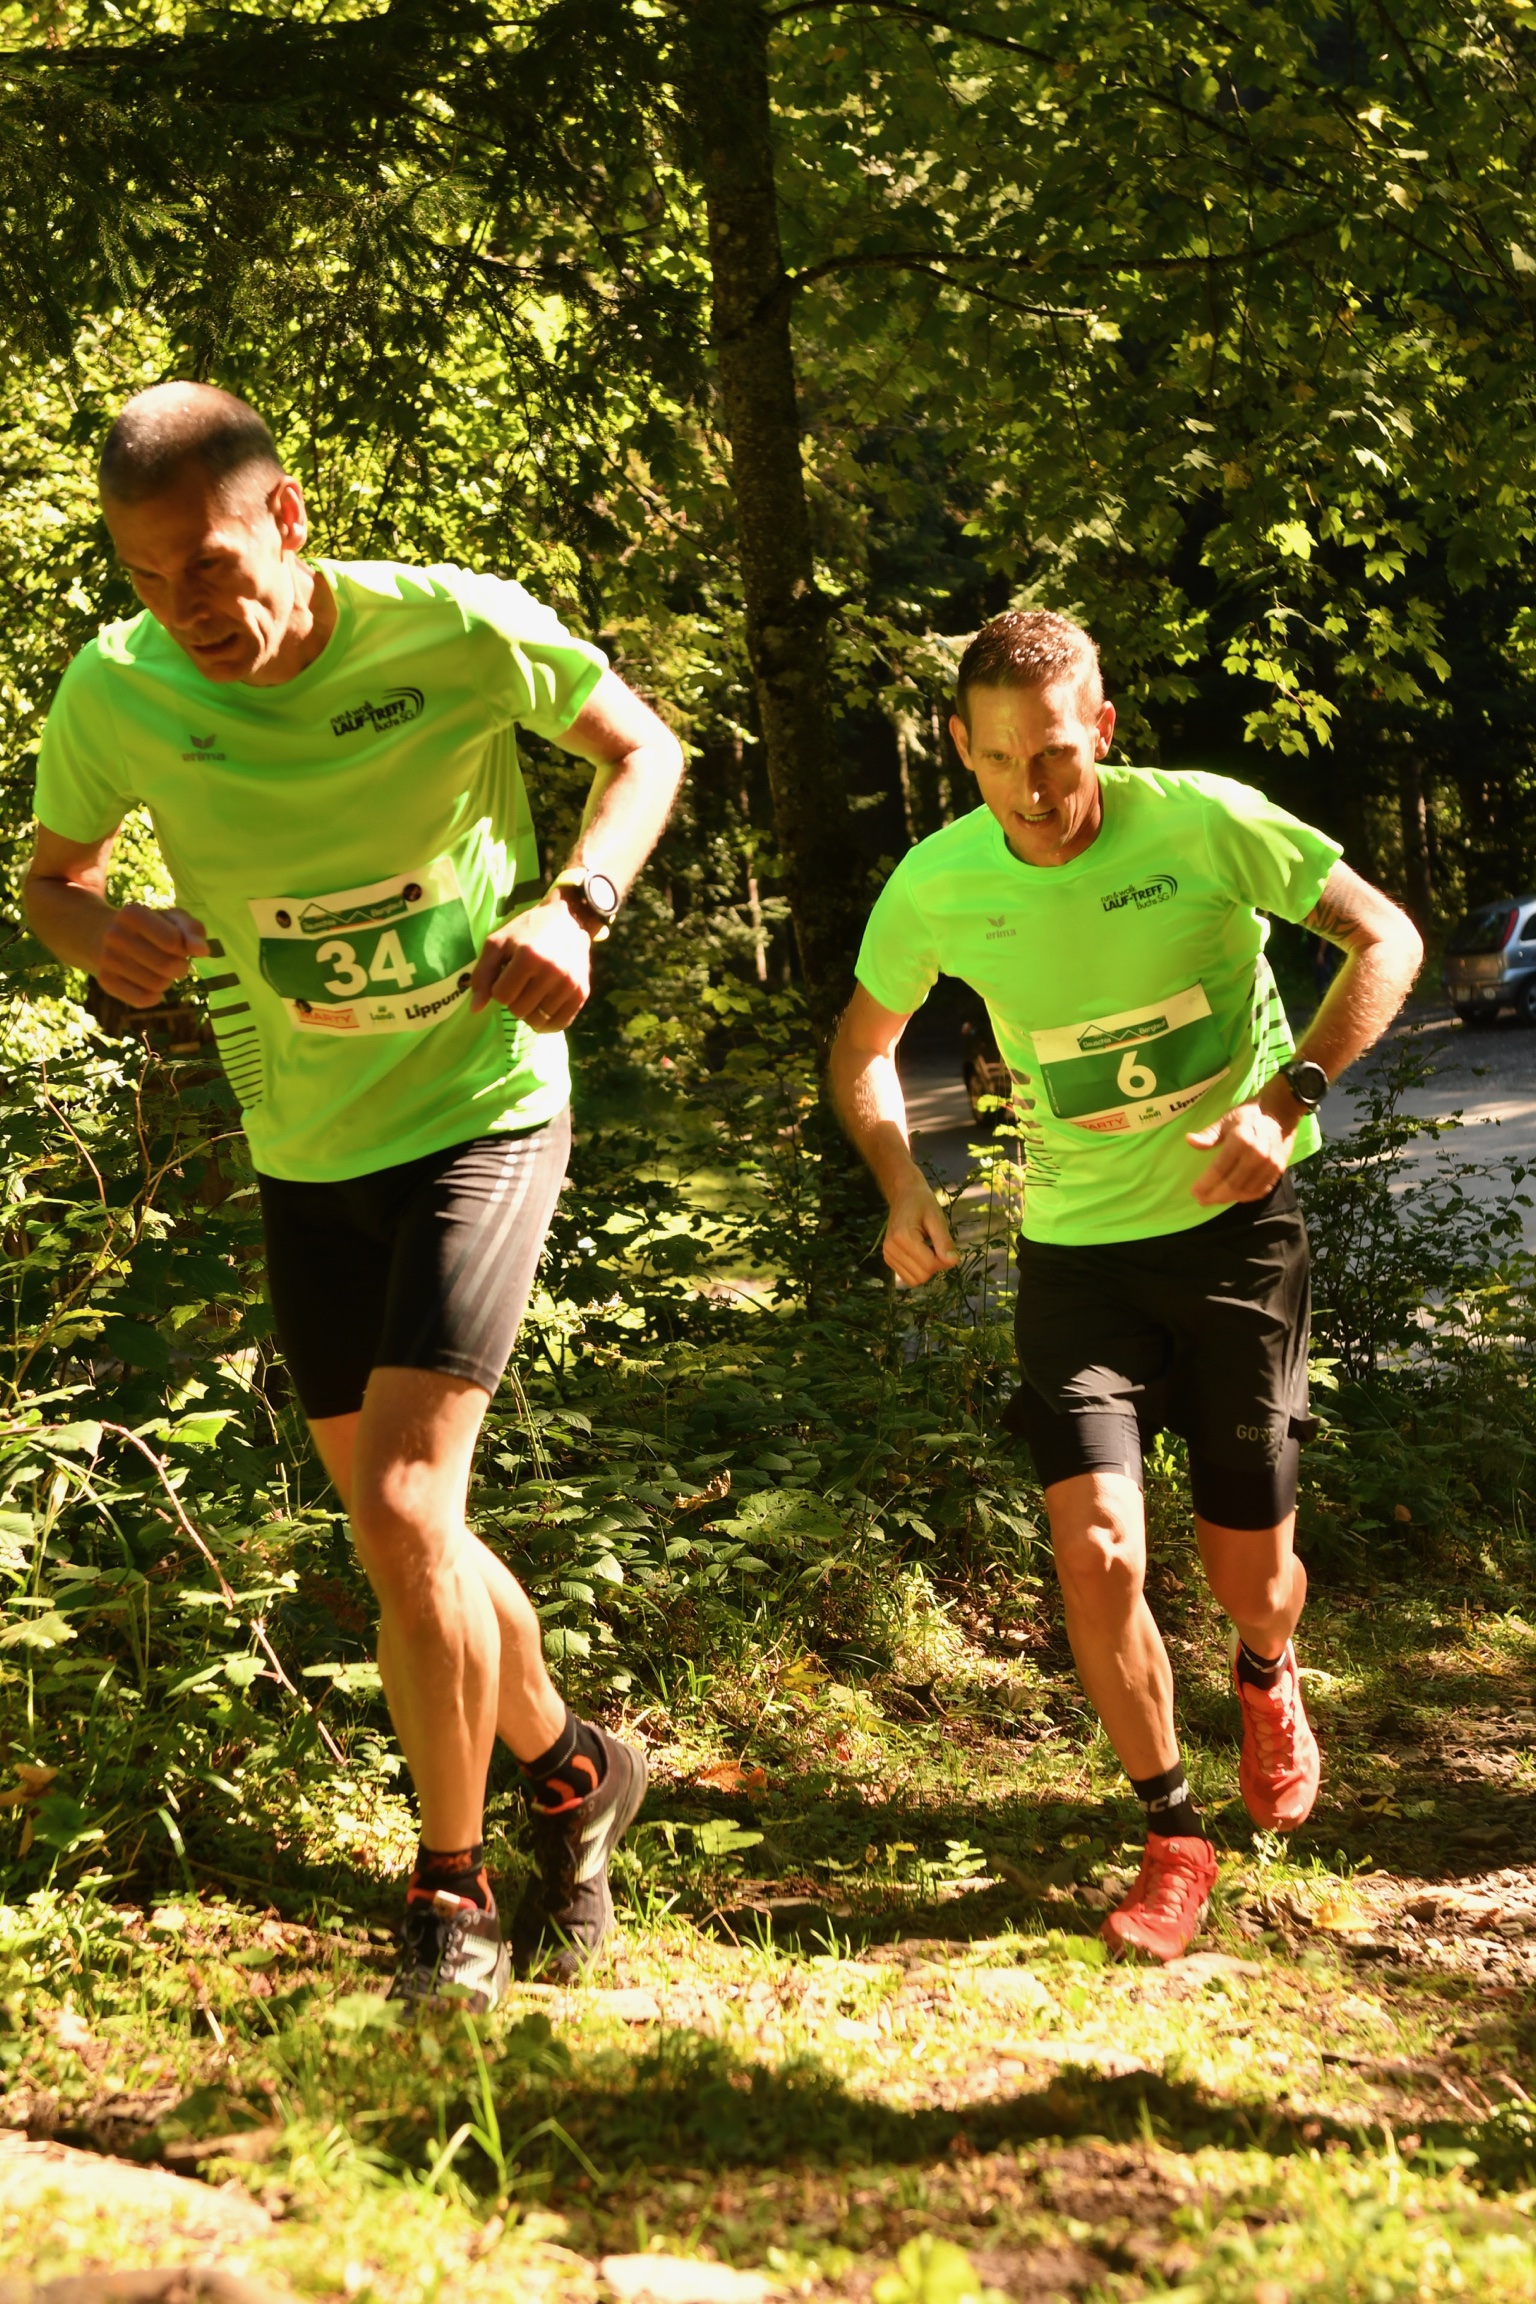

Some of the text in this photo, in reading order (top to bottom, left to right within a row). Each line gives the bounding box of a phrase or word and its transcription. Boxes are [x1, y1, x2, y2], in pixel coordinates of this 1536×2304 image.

[332, 699, 406, 736] LAUF-TREFF
[182, 752, 227, 762] erima
[1102, 884, 1162, 912] LAUF-TREFF
[985, 928, 1017, 940] erima
[315, 928, 417, 997] 34
[404, 989, 463, 1020] Lippun
[1116, 1050, 1158, 1098] 6
[1138, 1111, 1162, 1121] Landi
